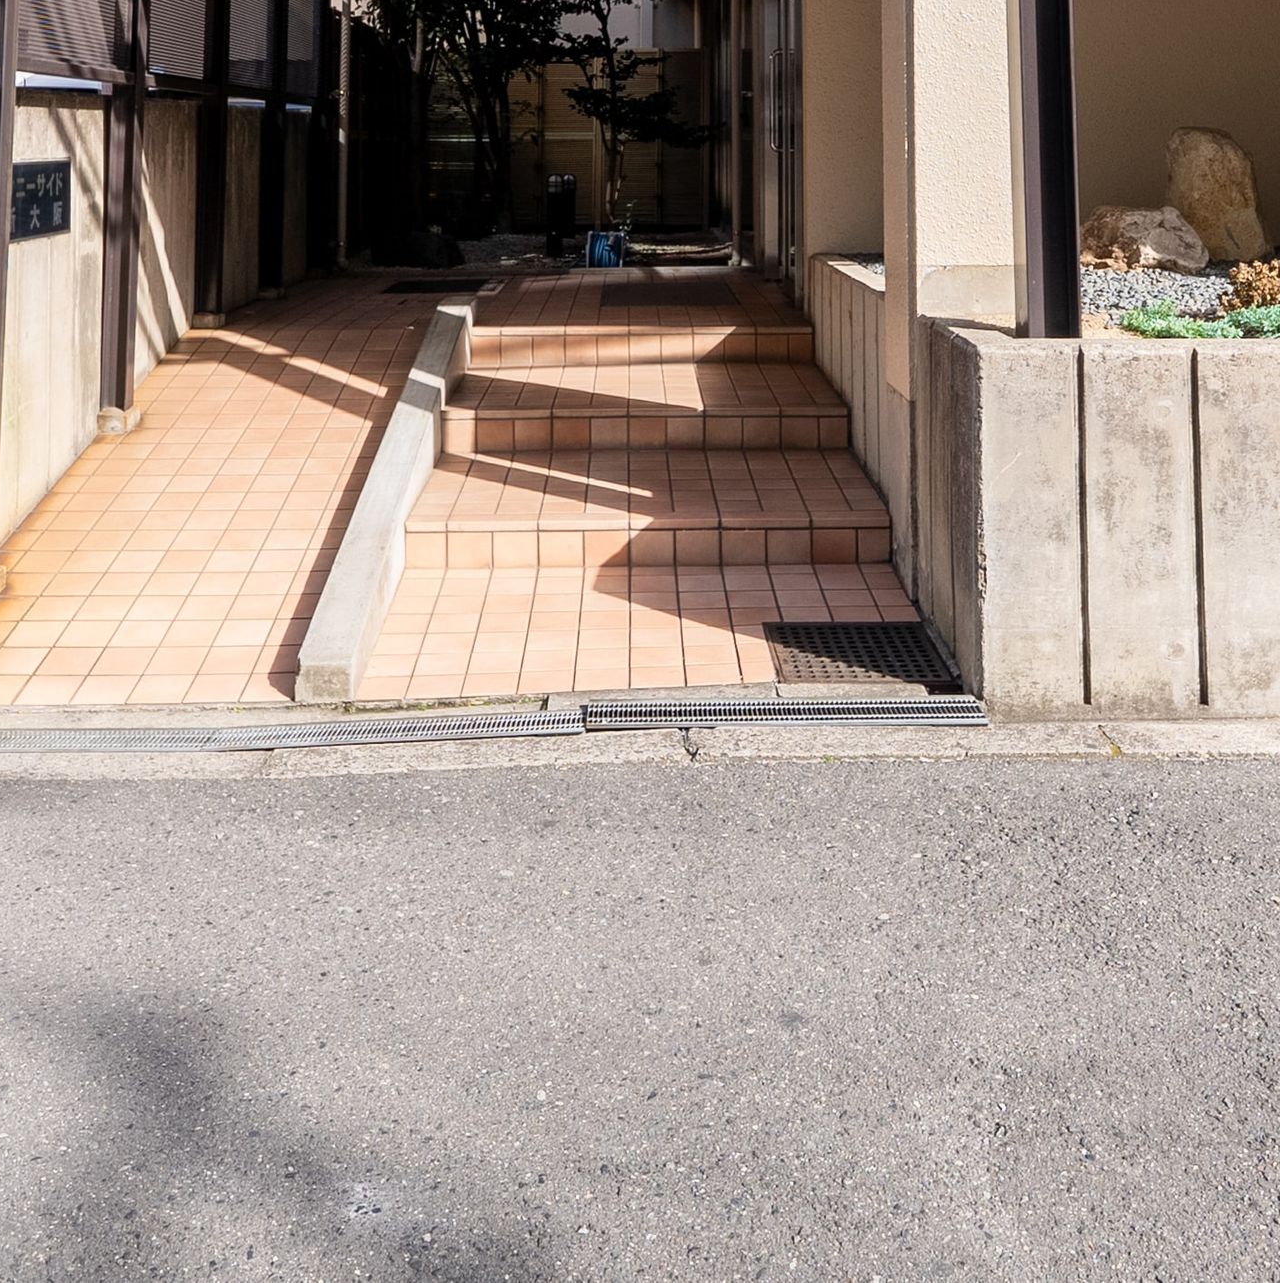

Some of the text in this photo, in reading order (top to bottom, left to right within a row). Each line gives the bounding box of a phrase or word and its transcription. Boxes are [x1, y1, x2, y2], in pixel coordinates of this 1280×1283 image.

[12, 172, 63, 197] ニーサイド
